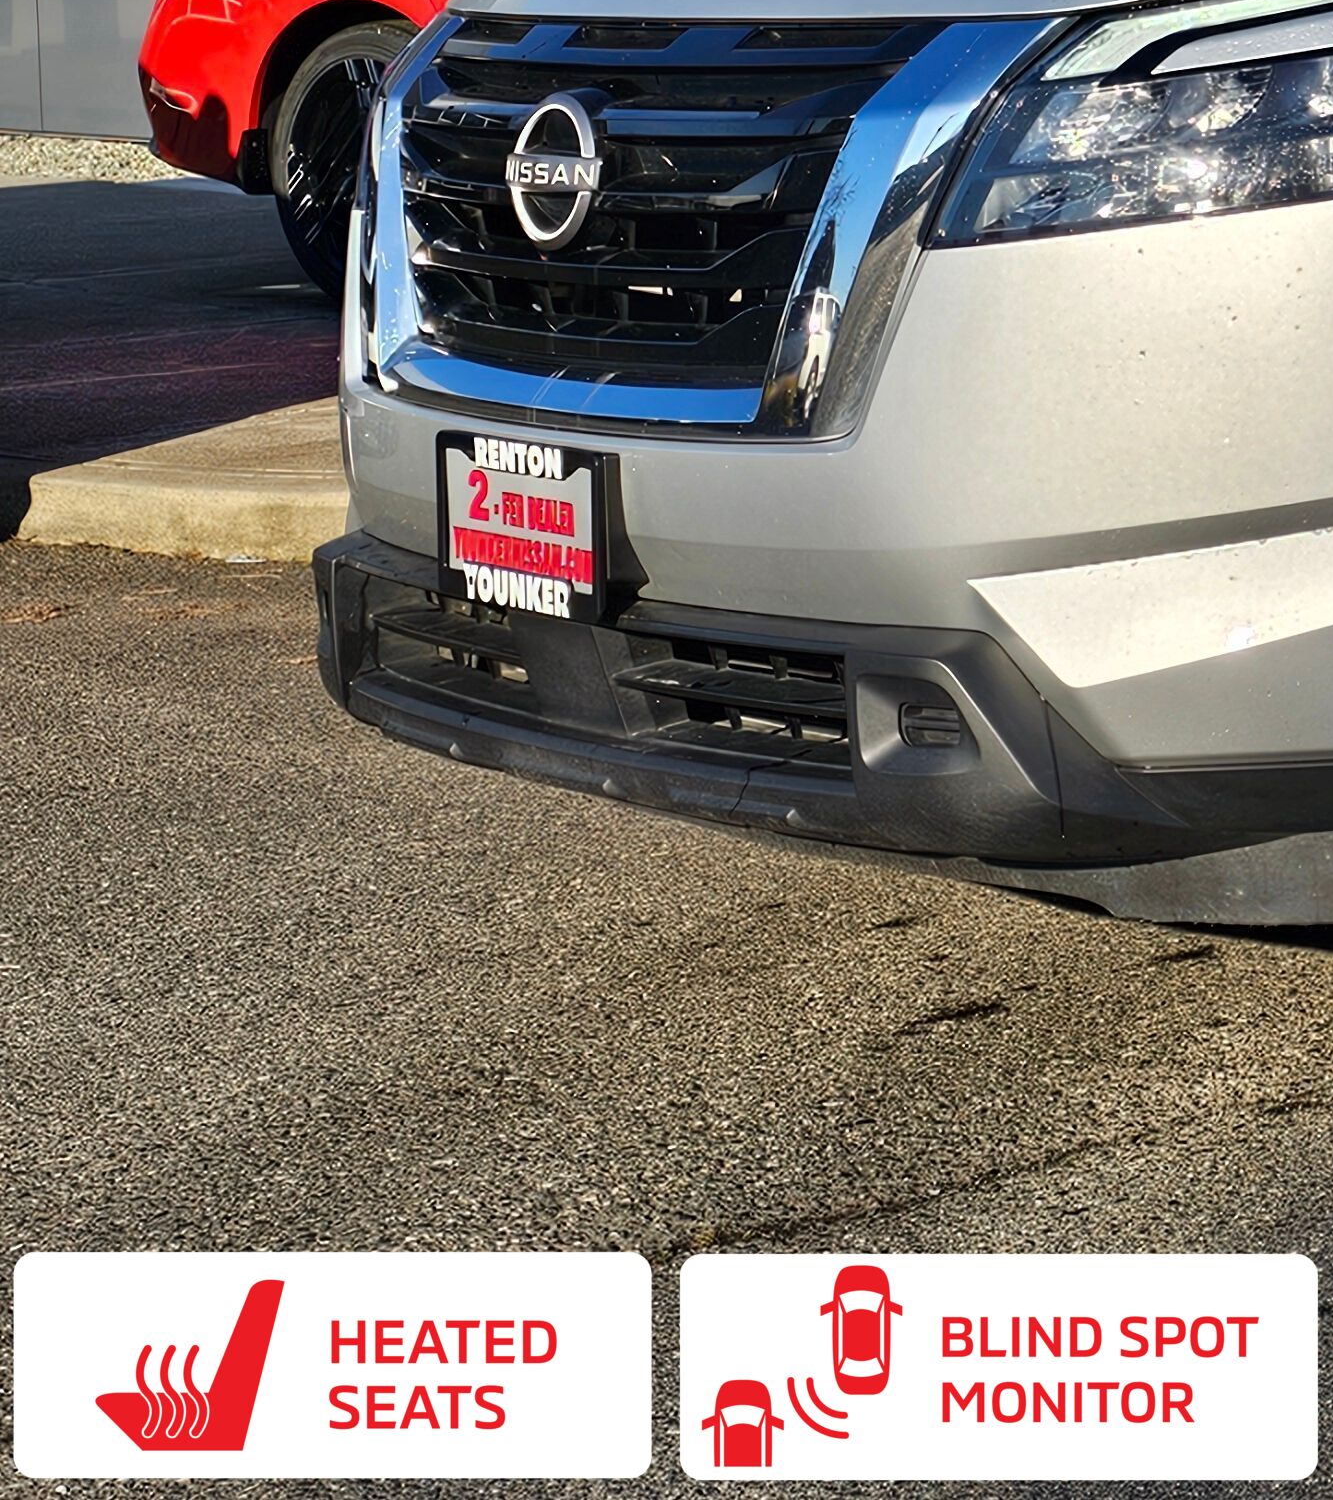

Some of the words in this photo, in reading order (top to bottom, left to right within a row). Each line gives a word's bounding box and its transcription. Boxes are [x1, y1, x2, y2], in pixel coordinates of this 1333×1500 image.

[505, 159, 596, 187] NISSAN
[473, 436, 564, 480] RENTON
[467, 469, 490, 522] 2
[462, 562, 571, 619] YOUNKER
